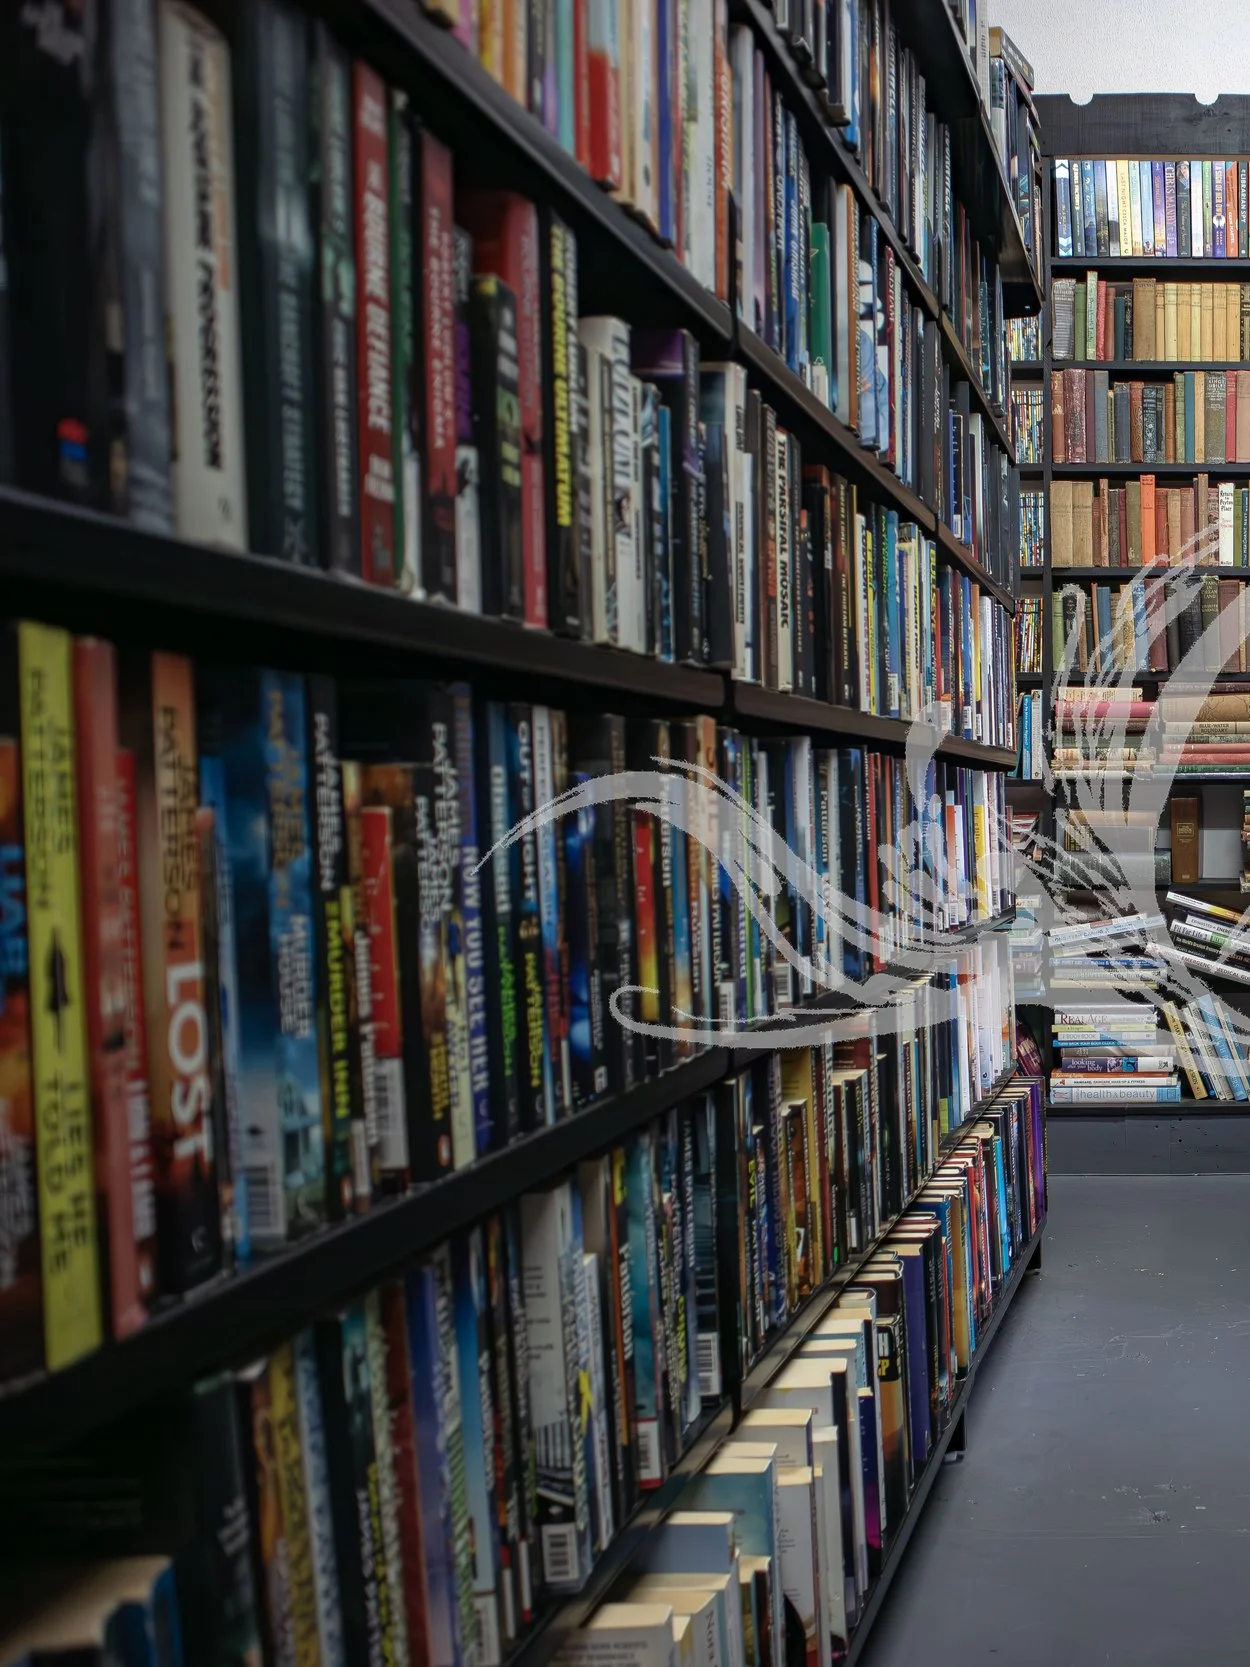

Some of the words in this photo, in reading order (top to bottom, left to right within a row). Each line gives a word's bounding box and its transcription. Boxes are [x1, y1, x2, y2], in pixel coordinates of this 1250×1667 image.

[1120, 188, 1128, 208] NIGHT
[1166, 166, 1176, 194] CHRIS
[1167, 195, 1177, 225] MANBY
[1215, 184, 1221, 192] OF
[364, 192, 389, 300] BOURNE
[428, 207, 440, 245] THE
[550, 225, 566, 270] THE
[791, 240, 799, 301] GRISHAM
[429, 256, 442, 350] BOURNE
[565, 234, 579, 321] ROBERT
[199, 262, 223, 470] PROGRESSION
[366, 302, 392, 434] DEFIANCE
[551, 271, 567, 377] BOURNE
[431, 359, 445, 450] ENIGMA
[612, 336, 632, 484] LUDLUM
[553, 380, 572, 526] ULTIMATUM
[779, 440, 787, 470] THE
[779, 475, 789, 554] PARSIFAL
[780, 561, 791, 627] MOSAIC
[27, 667, 52, 912] PATTERSON
[50, 720, 74, 856] JAMES
[518, 720, 532, 787] OUT
[114, 775, 134, 880] JAMES
[160, 706, 188, 953] PATTERSON
[179, 757, 198, 891] JAMES
[314, 713, 334, 890] PATTERSON
[326, 752, 340, 854] JAMES
[433, 722, 454, 911] PATTERSON
[446, 762, 462, 867] JAMES
[489, 765, 511, 914] Obsessed
[821, 790, 829, 863] Patterson
[427, 833, 442, 921] JAMES
[462, 846, 482, 909] NOW
[353, 930, 373, 1017] James
[466, 916, 484, 970] YOU
[691, 901, 700, 993] Russian
[1173, 924, 1181, 933] Fit
[1181, 926, 1192, 935] For
[1191, 929, 1203, 939] Life
[1181, 956, 1213, 970] EMERGENC
[120, 888, 141, 1072] PATTERSON
[278, 934, 295, 1033] HOUSE
[290, 914, 311, 1040] MURDER
[326, 920, 348, 1050] MURDER
[468, 975, 487, 1032] SEE
[496, 926, 513, 1077] PATTERSON
[506, 962, 518, 1046] JAMES
[524, 952, 540, 1088] PATTERSON
[533, 984, 545, 1058] JAMES
[165, 958, 213, 1172] LOST
[334, 1059, 351, 1119] INN
[357, 1024, 380, 1148] Patterson
[430, 1048, 442, 1120] MONTH
[472, 1038, 490, 1093] HER
[1071, 1058, 1097, 1068] looking
[1080, 1087, 1114, 1100] health
[1113, 1089, 1120, 1099] &
[1120, 1088, 1155, 1101] beauty
[1087, 1063, 1103, 1072] body
[42, 1074, 63, 1194] TOLD
[684, 1120, 694, 1171] JAMES
[685, 1175, 696, 1268] PATTERSON
[747, 1159, 756, 1208] EVIL
[47, 1214, 68, 1274] ME
[657, 1238, 668, 1300] JAMES
[751, 1219, 761, 1321] PATTERSON
[618, 1242, 634, 1359] Patterson
[662, 1305, 676, 1409] PATTERSON
